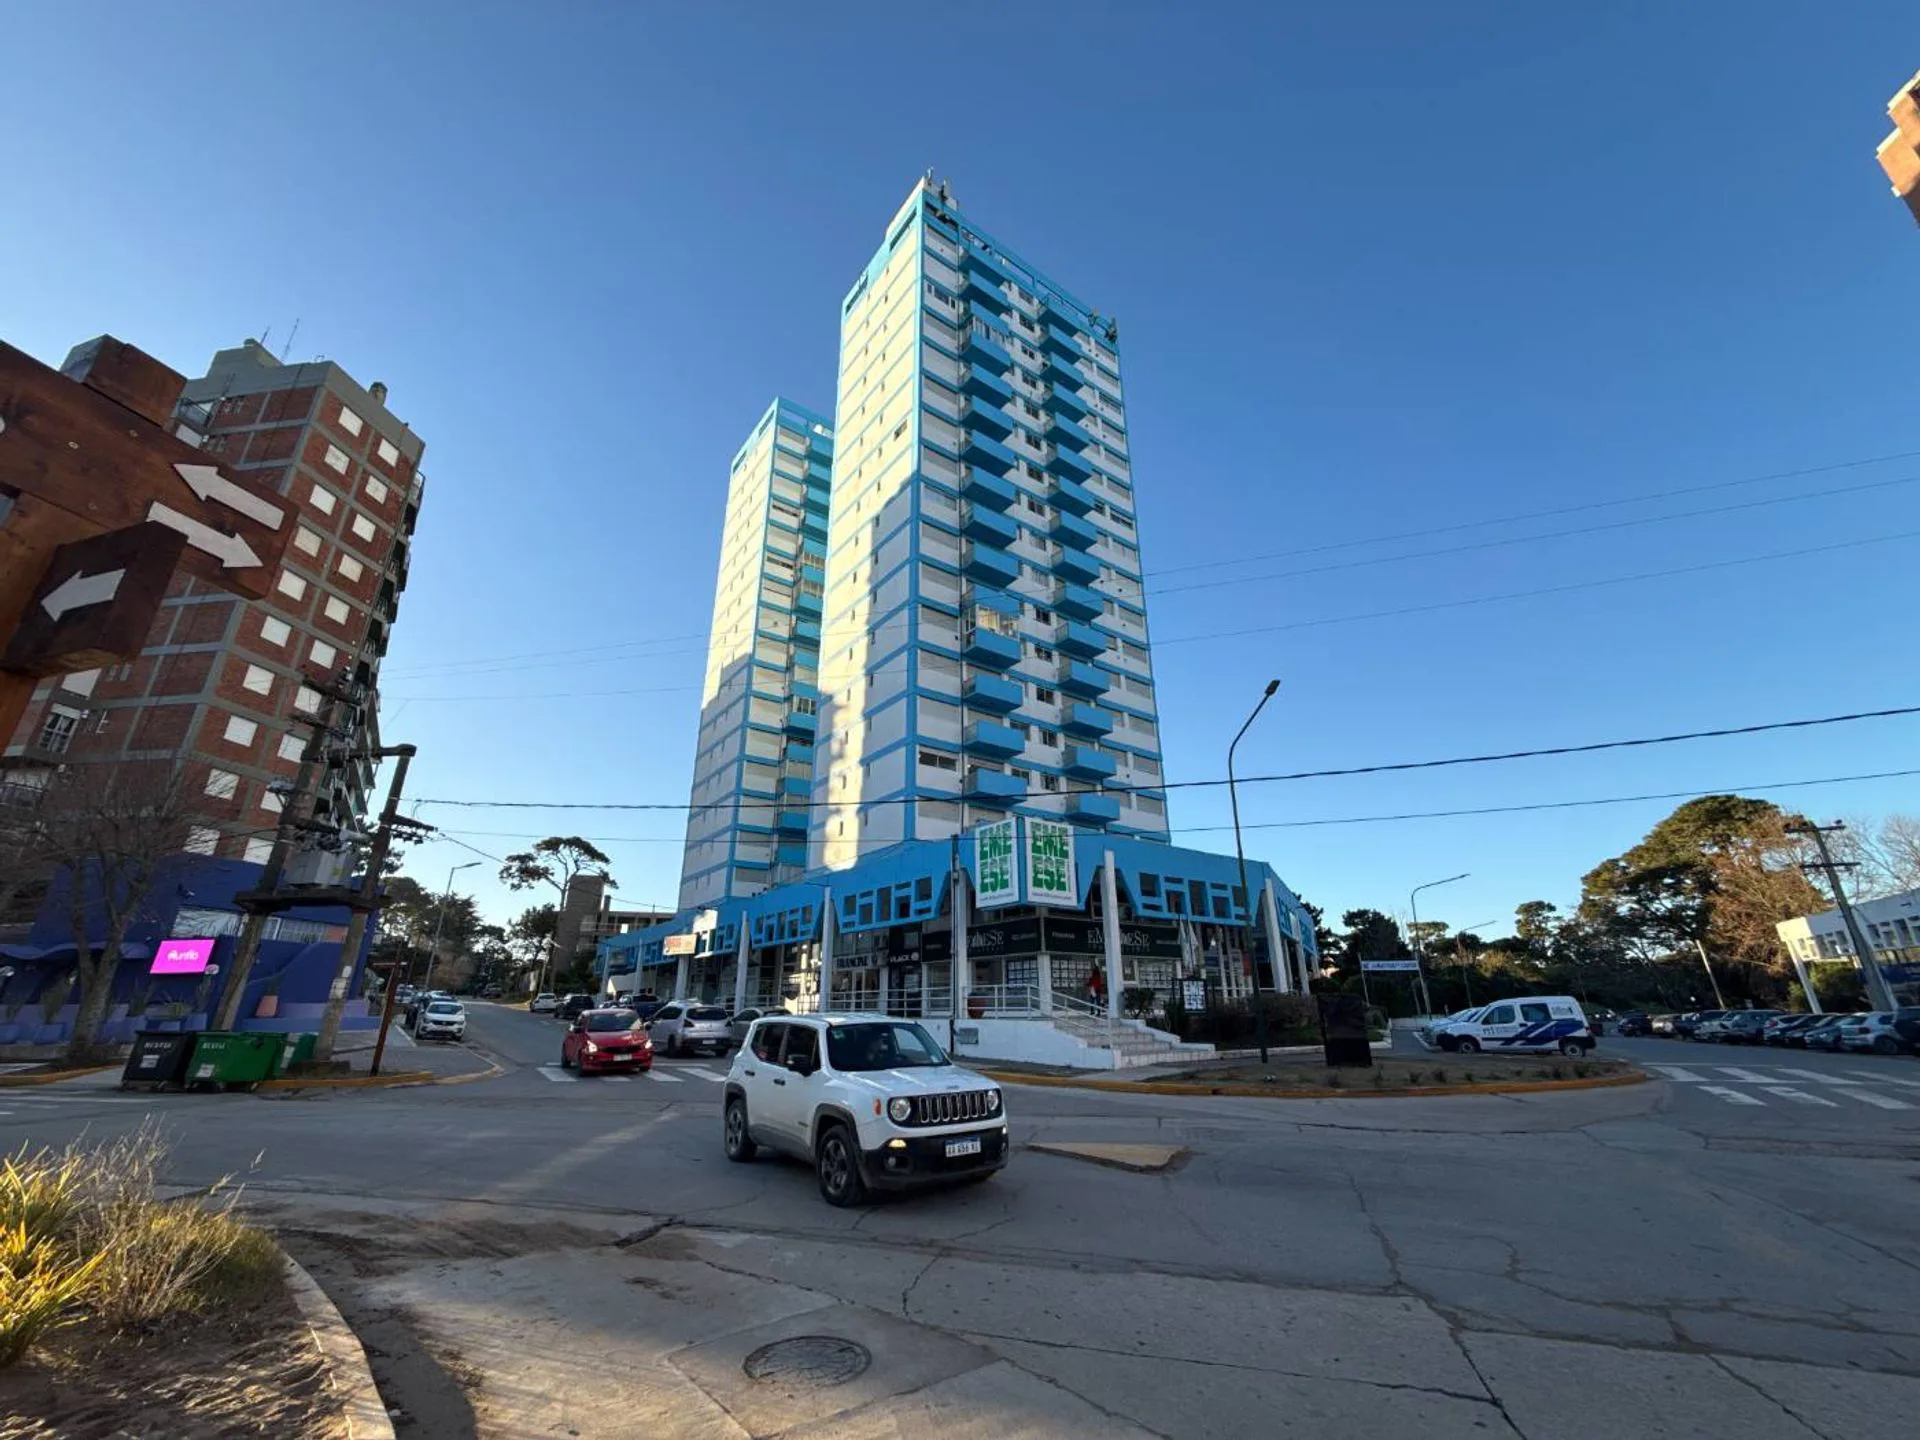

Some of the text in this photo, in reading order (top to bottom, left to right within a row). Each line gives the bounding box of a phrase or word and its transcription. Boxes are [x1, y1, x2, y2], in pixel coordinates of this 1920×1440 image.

[979, 821, 1012, 861] EME
[1030, 821, 1070, 860] EME
[980, 855, 1011, 894] ESE
[1031, 855, 1069, 892] ESE
